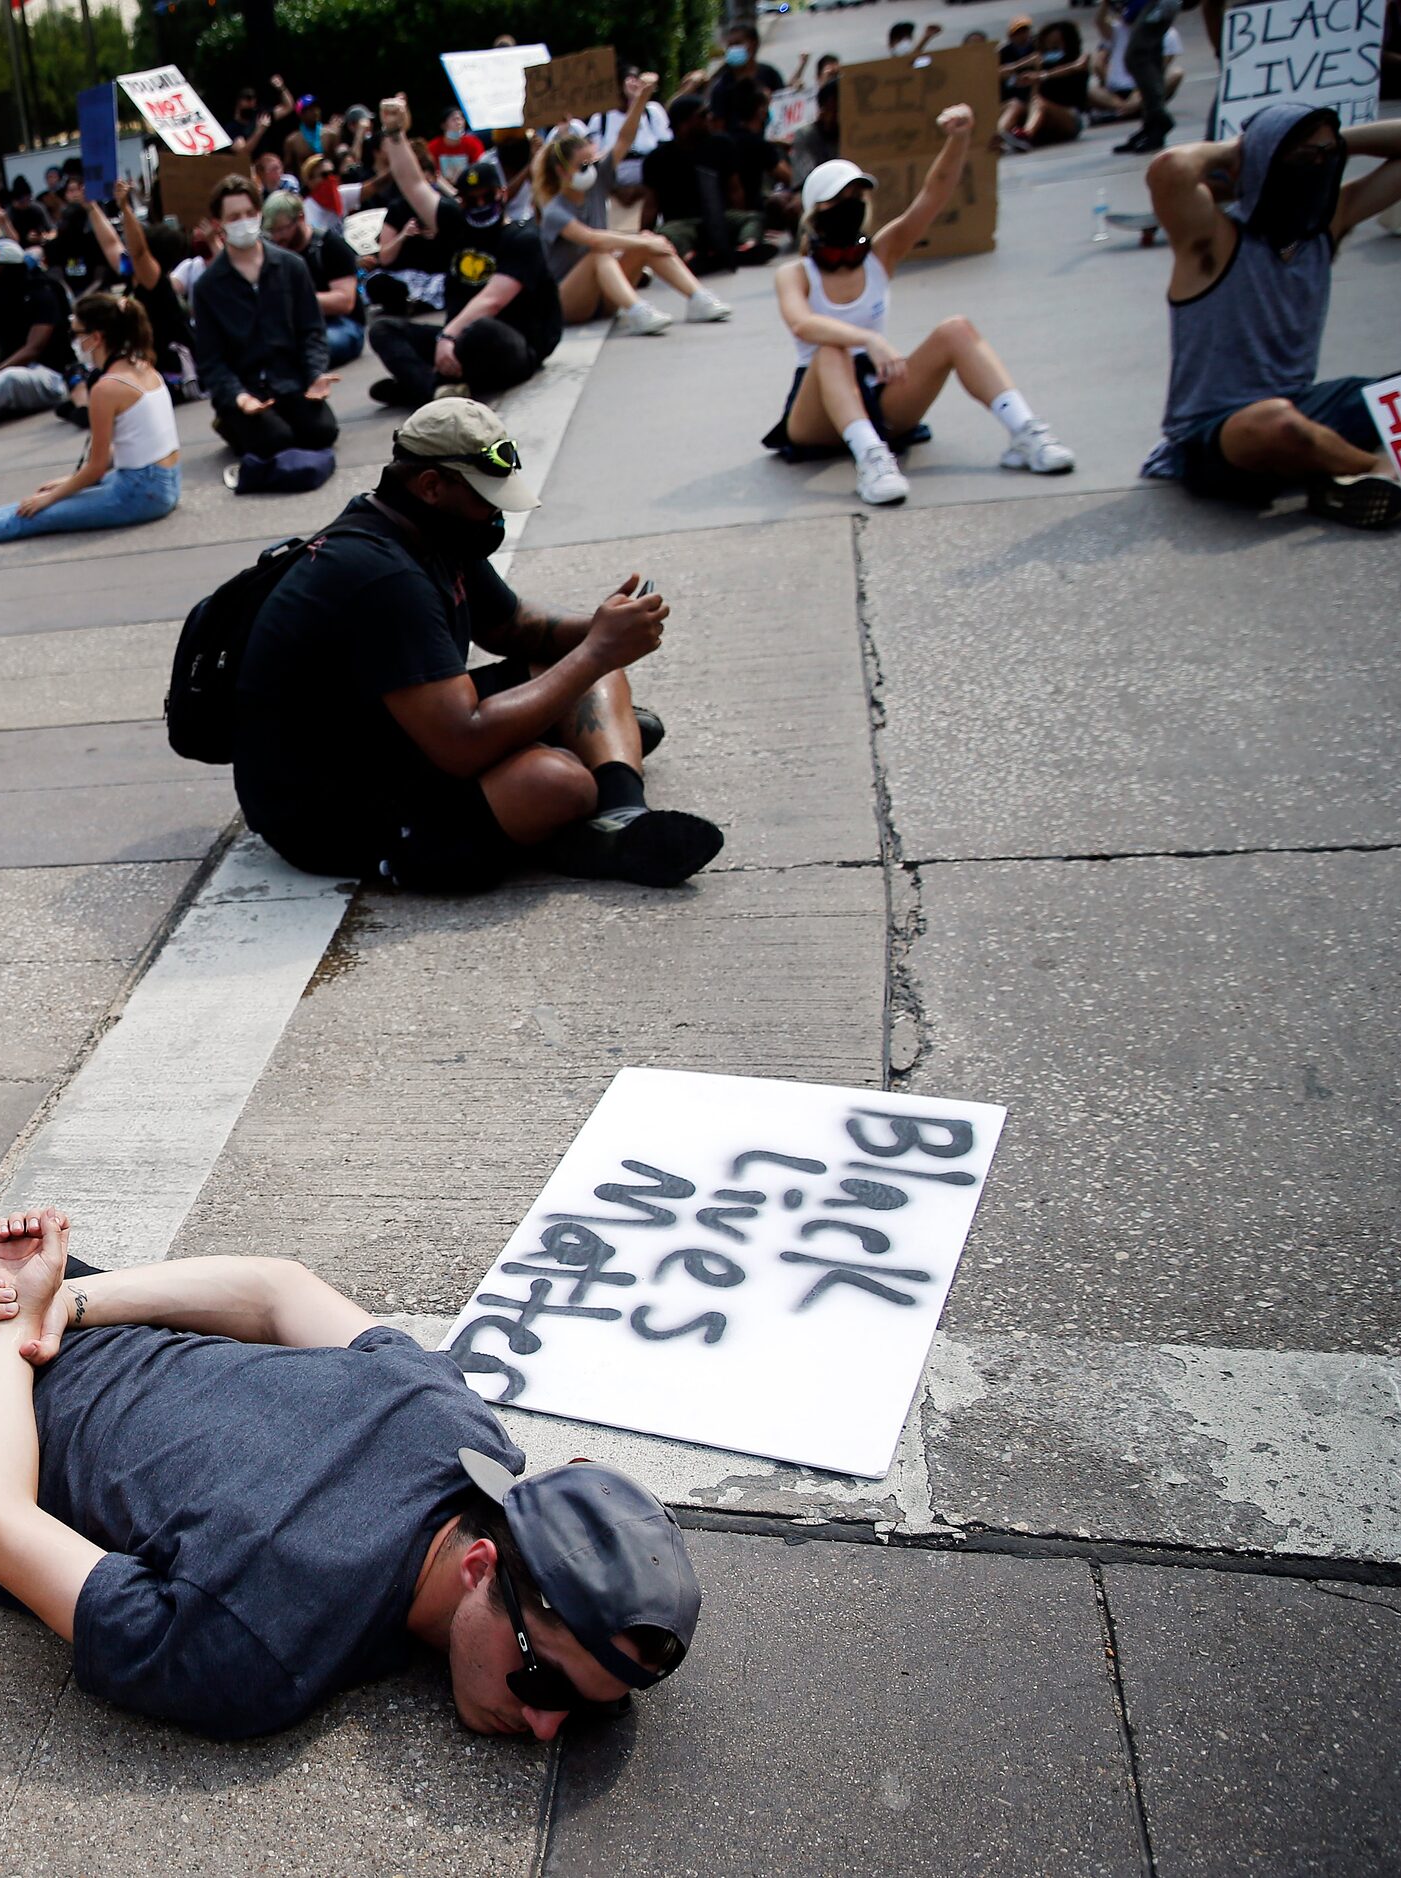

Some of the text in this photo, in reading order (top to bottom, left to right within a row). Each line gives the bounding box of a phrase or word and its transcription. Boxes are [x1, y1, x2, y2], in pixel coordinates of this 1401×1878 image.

[1227, 0, 1381, 62] BLACK
[1222, 43, 1380, 104] LIVES
[145, 93, 187, 118] NOT
[172, 124, 215, 153] US
[778, 1107, 976, 1313] Black
[629, 1149, 828, 1346] Lives
